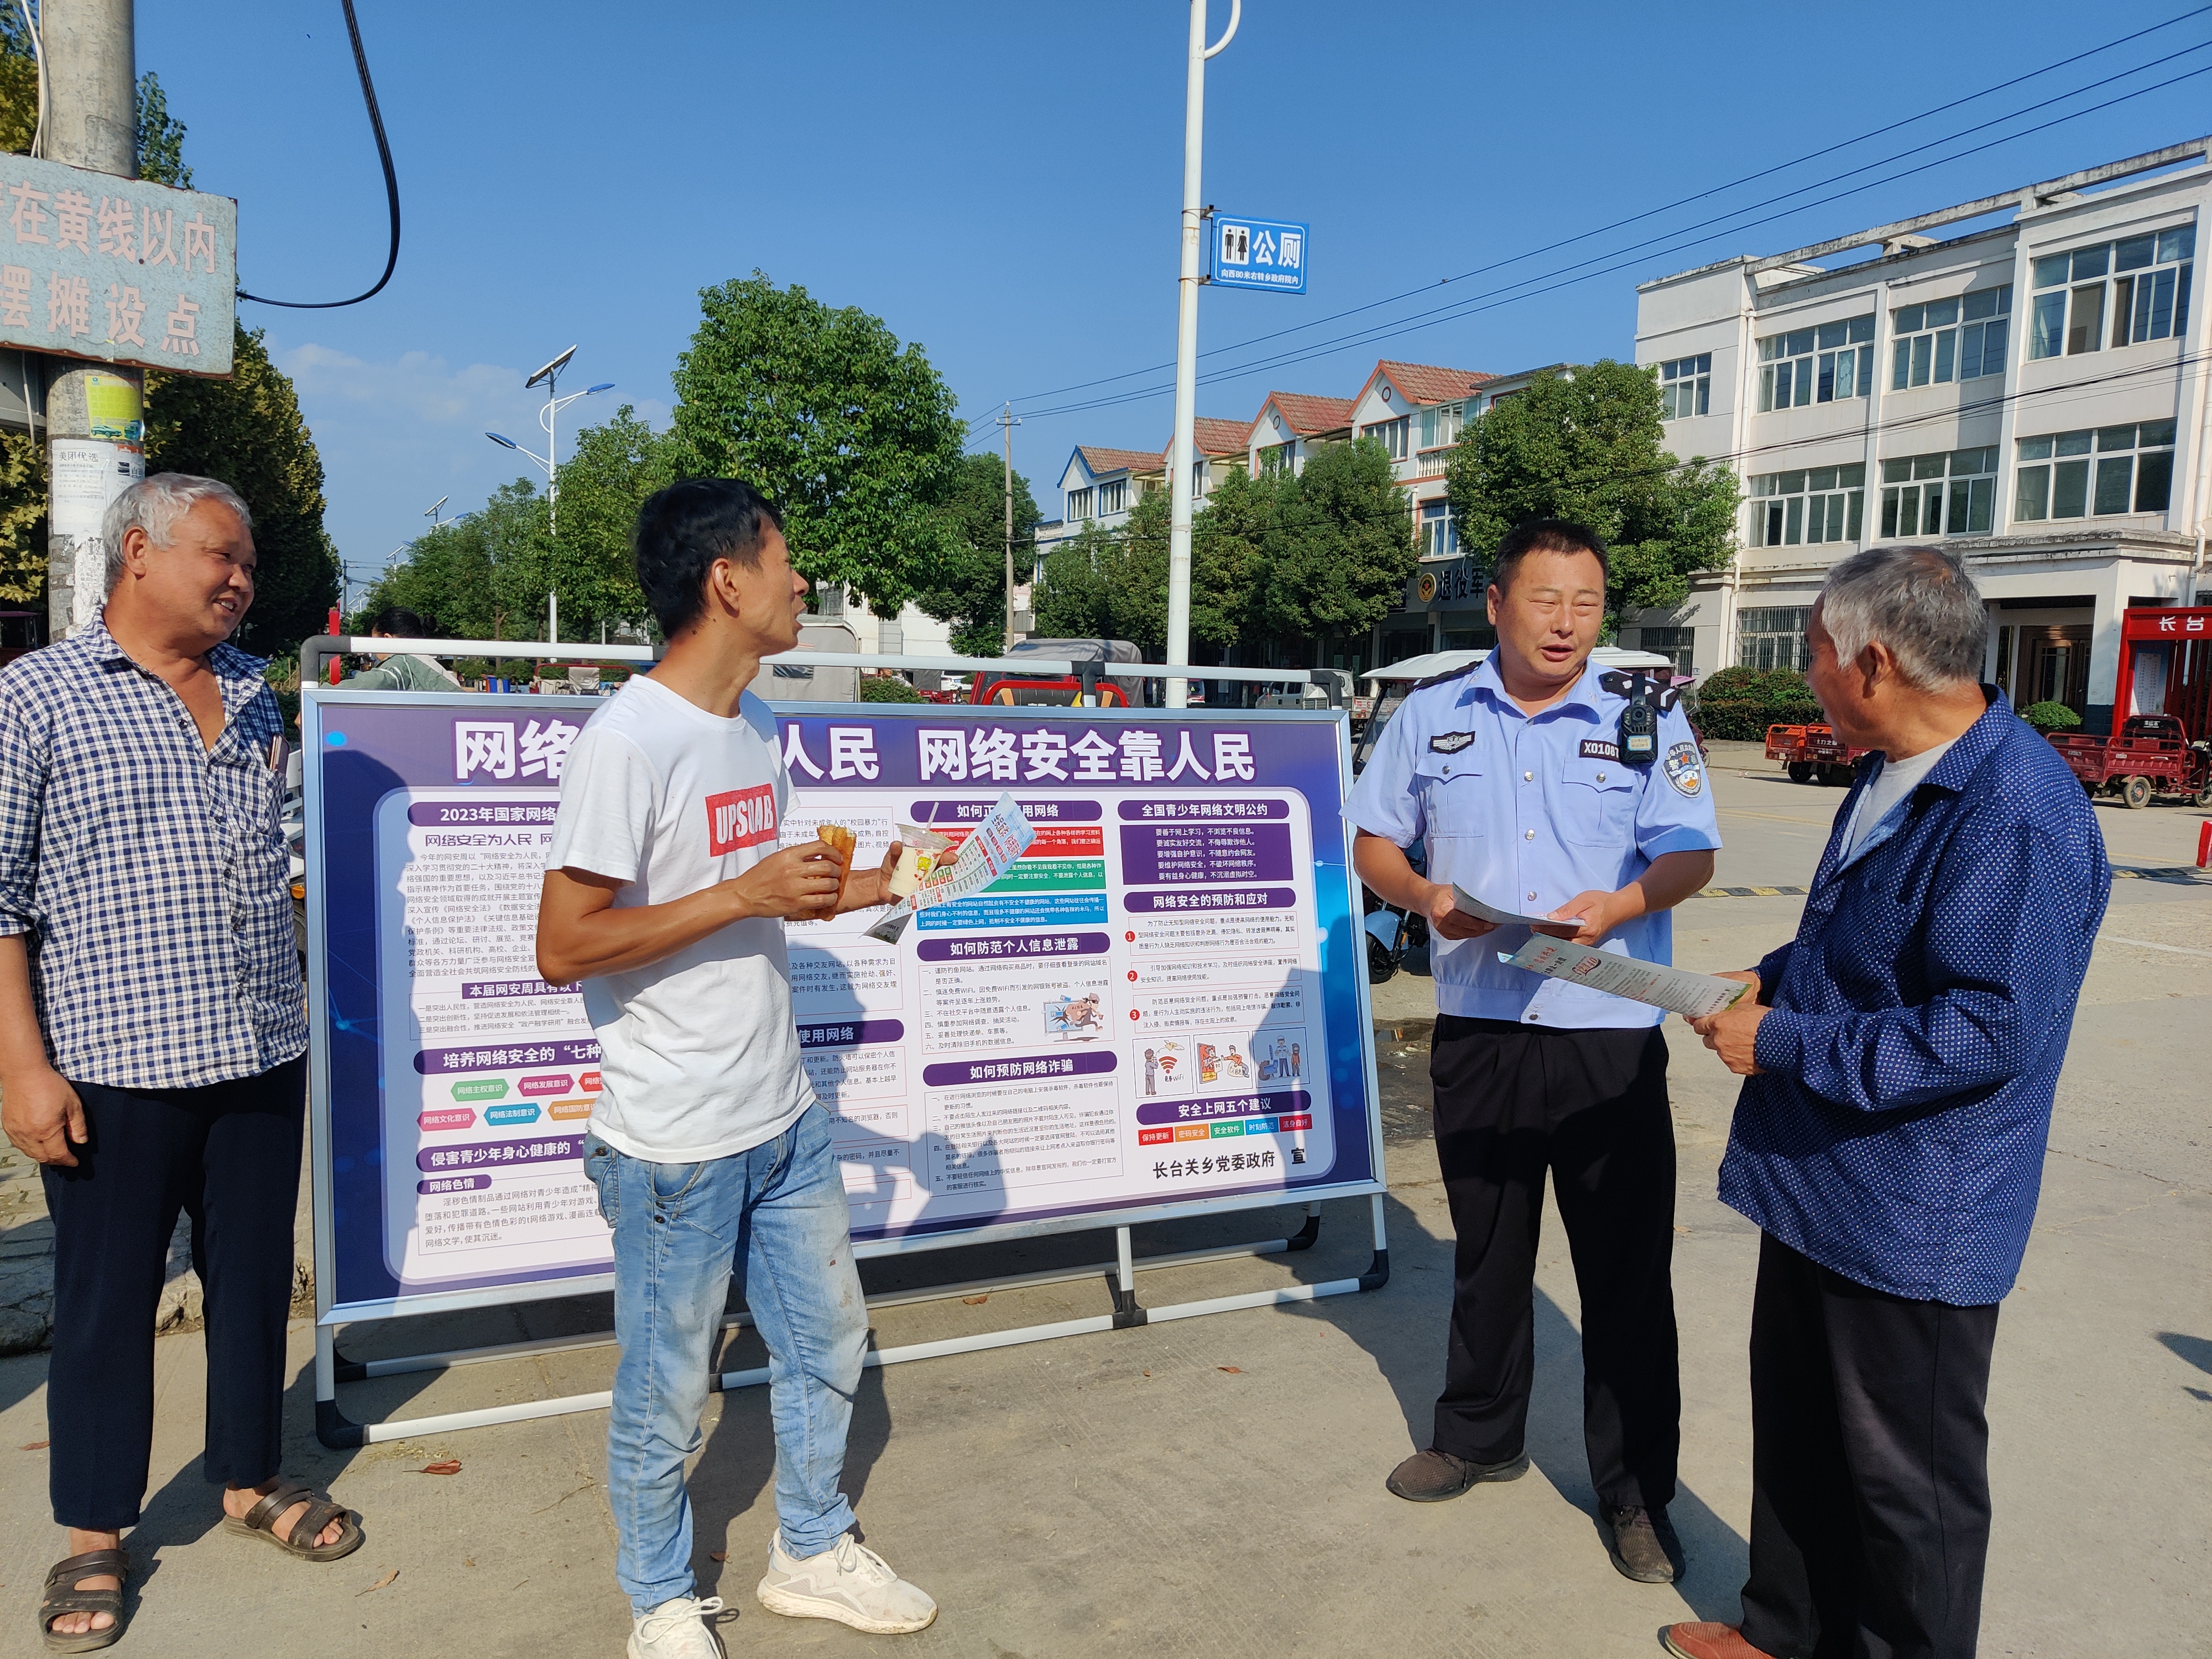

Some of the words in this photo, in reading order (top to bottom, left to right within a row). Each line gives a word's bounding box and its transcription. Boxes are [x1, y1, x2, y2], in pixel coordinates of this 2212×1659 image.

[0, 180, 216, 273] 在黄线以内
[1253, 230, 1301, 269] 公厕
[1221, 268, 1298, 285] 向西80米右转乡政府院内
[2159, 615, 2204, 632] 长台
[919, 728, 1255, 782] 网络安全靠人民
[1141, 804, 1268, 817] 全国青少年网络文明公约
[781, 818, 888, 827] 实中针对未成年人的“校园暴力”行
[425, 833, 532, 847] 网络安全为人民
[406, 883, 543, 893] 指示精神作为首要任务，围绕党的十八
[1153, 893, 1268, 909] 网络安全的预防和应对
[408, 924, 537, 935] 保护条例》等重要法律法规、政策文
[950, 938, 1079, 956] 如何防范个人信息泄露
[419, 1017, 589, 1033] 三是突出融合性，推进网络安全“政产融学研用”融合发
[798, 1026, 854, 1044] 使用网络
[805, 1063, 896, 1076] 站，还能防止网站服务器在你不
[970, 1058, 1073, 1079] 如何预防网络诈骗
[457, 1084, 503, 1095] 网络主权意识
[524, 1079, 568, 1090] 网络发展意识
[1178, 1097, 1271, 1118] 安全上网五个建议
[424, 1113, 470, 1124] 网络文化意识
[490, 1108, 535, 1119] 网络法制意识
[1142, 1131, 1170, 1142] 保持更新
[1178, 1128, 1205, 1138] 密码安全
[1214, 1125, 1240, 1135] 安全软件
[1248, 1121, 1275, 1131] 时刻防范
[1153, 1150, 1275, 1179] 长台关乡党委政府
[1290, 1147, 1306, 1165] 宣
[430, 1178, 475, 1192] 网络色情
